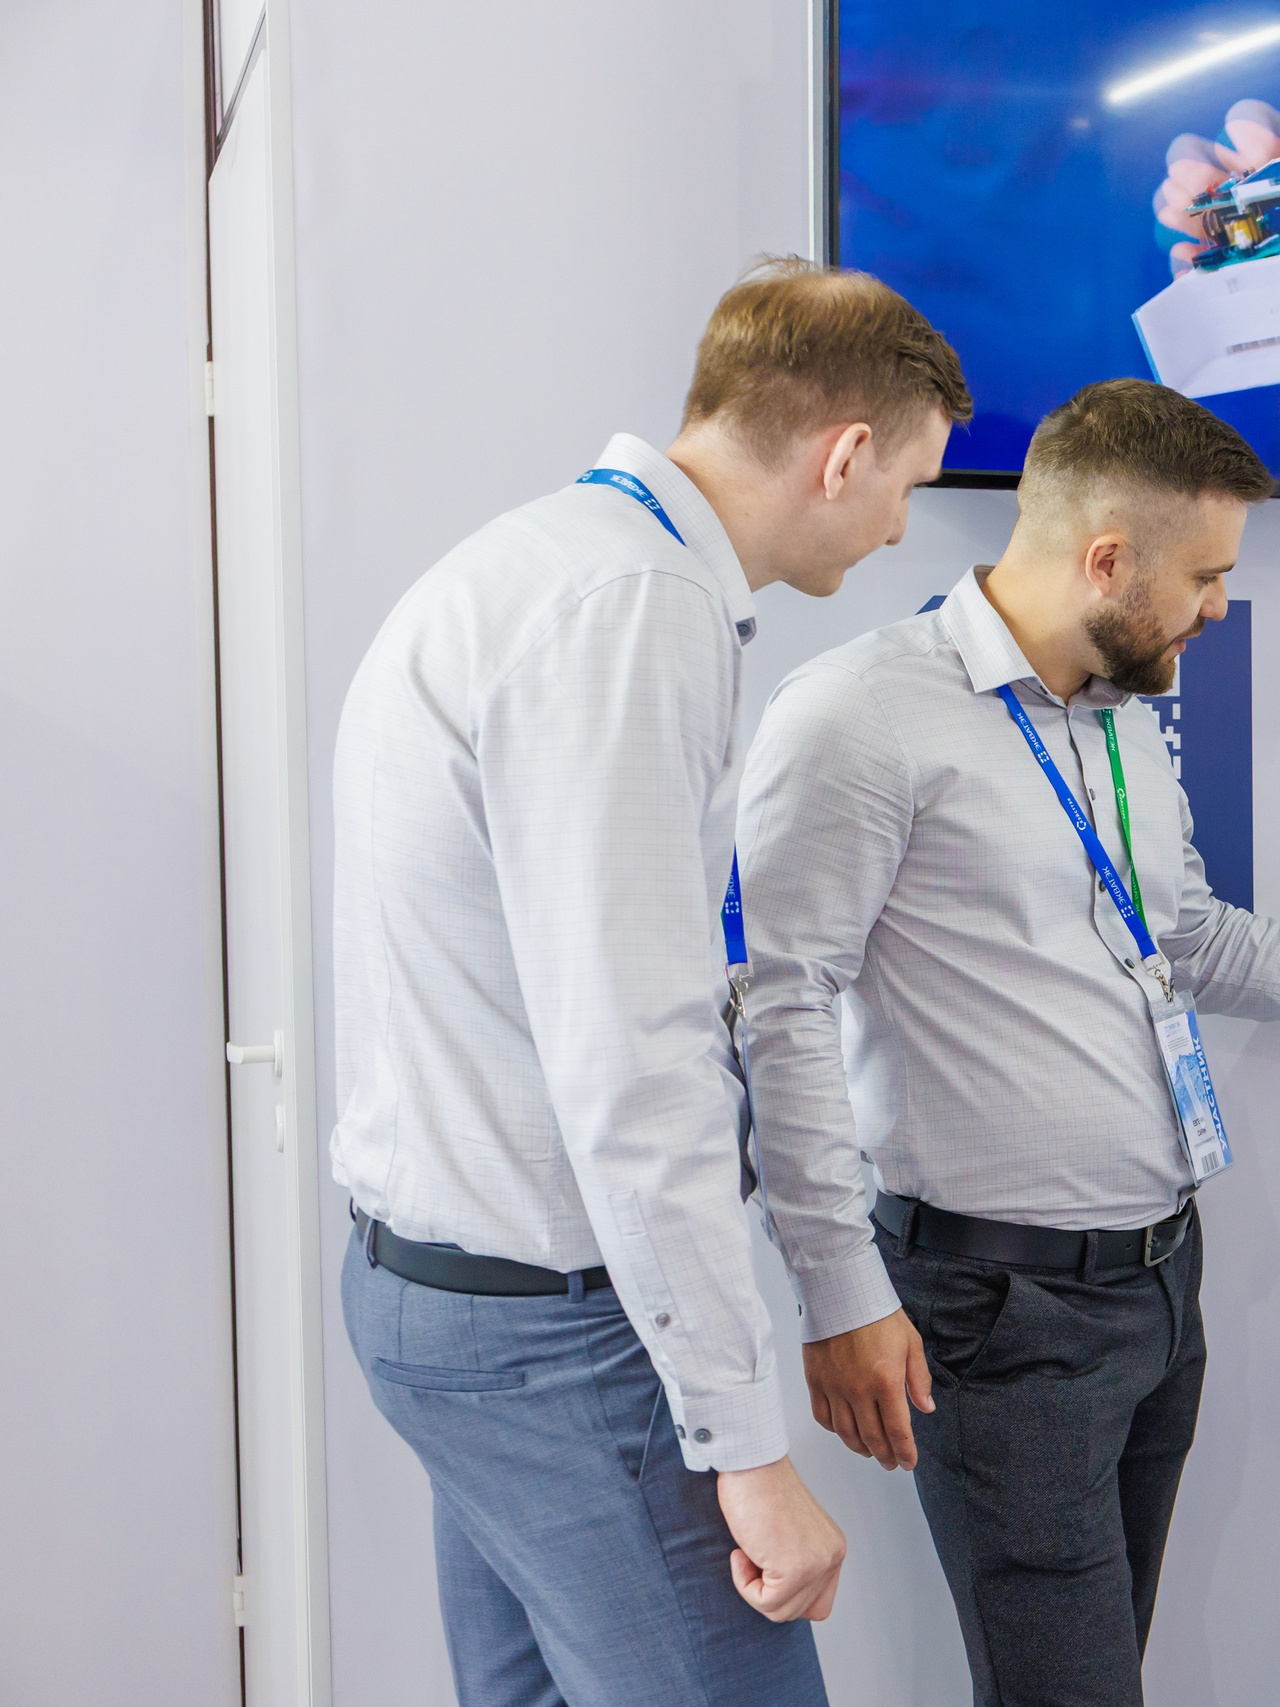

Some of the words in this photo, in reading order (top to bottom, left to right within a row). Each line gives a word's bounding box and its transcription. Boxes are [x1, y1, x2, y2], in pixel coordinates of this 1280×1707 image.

[1016, 712, 1041, 751] ЭКВАТЭК
[1101, 866, 1127, 906] ЭКВАТЭК
[1193, 1036, 1227, 1151] УЧАСТНИК
